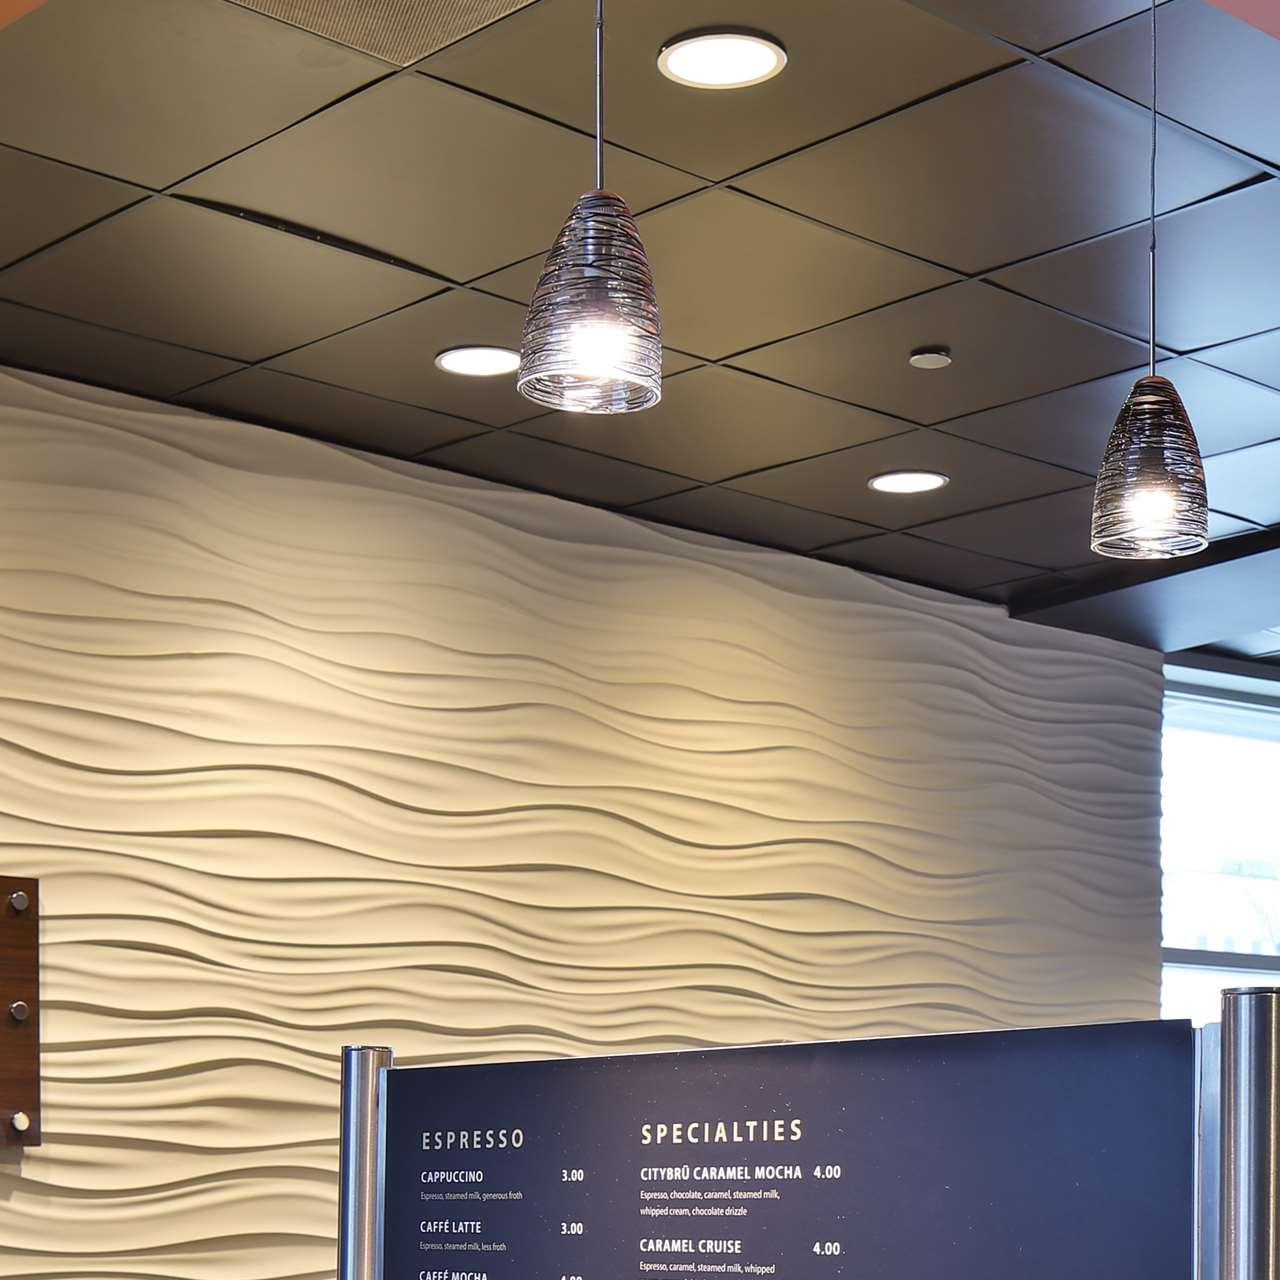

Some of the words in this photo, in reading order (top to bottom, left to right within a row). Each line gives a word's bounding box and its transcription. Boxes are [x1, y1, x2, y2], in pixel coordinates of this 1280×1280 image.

[423, 1129, 523, 1149] ESPRESSO
[642, 1120, 801, 1144] SPECIALTIES
[421, 1171, 483, 1182] CAPPUCCINO
[562, 1170, 583, 1181] 3.00
[693, 1167, 751, 1180] CARAMEL
[755, 1166, 802, 1179] MOCHA
[814, 1166, 841, 1178] 4.00
[641, 1191, 669, 1200] Espresso,
[670, 1190, 703, 1199] chocolate,
[702, 1190, 732, 1199] caramel,
[733, 1190, 762, 1198] steamed
[764, 1190, 780, 1199] milk,
[640, 1206, 670, 1217] whipped
[690, 1207, 724, 1215] chocolate
[725, 1207, 747, 1215] drizzle
[420, 1220, 449, 1232] CAFFÉ
[453, 1222, 481, 1233] LATTE
[561, 1223, 583, 1234] 3.00
[640, 1239, 695, 1252] CARAMEL
[699, 1240, 741, 1253] CRUISE
[813, 1242, 841, 1255] 4.00
[640, 1261, 668, 1272] Espresso,
[669, 1263, 696, 1272] caramel,
[698, 1264, 726, 1272] steamed
[727, 1264, 743, 1273] milk,
[745, 1263, 775, 1275] whipped
